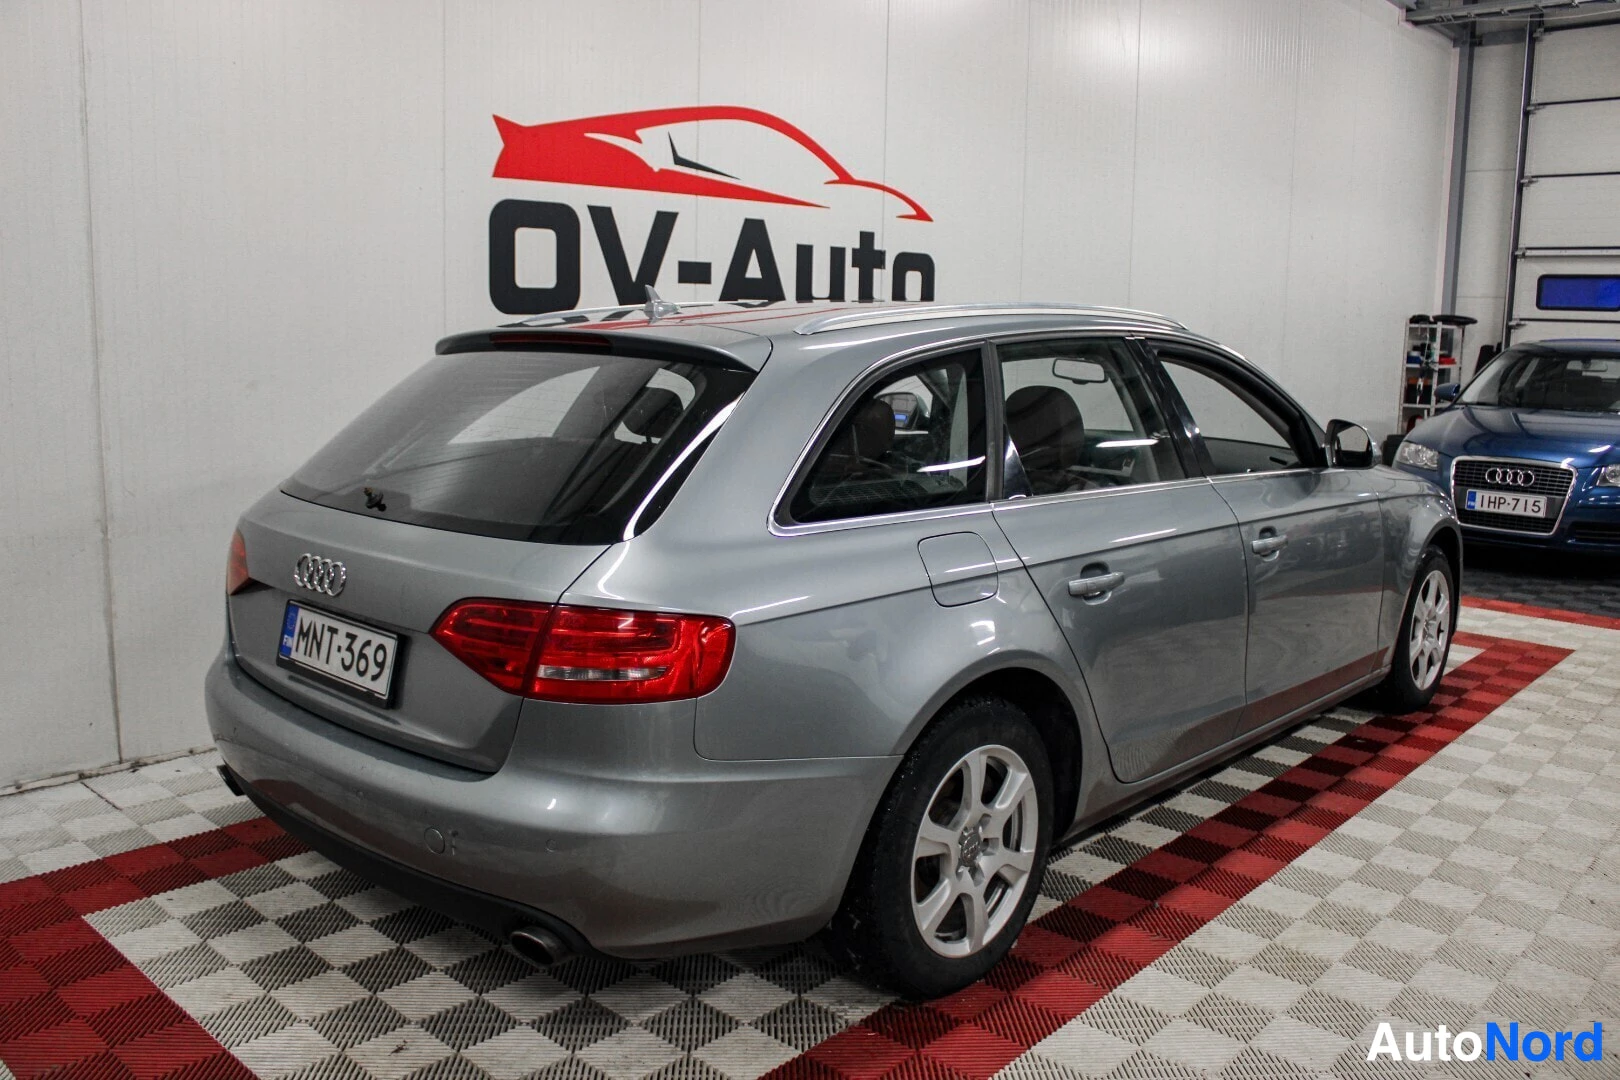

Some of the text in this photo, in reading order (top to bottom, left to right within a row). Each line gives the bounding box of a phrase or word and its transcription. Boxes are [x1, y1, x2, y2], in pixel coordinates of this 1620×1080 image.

[489, 198, 935, 315] OV-Auto
[1480, 494, 1541, 513] IHP-715
[295, 616, 387, 681] MNT-369
